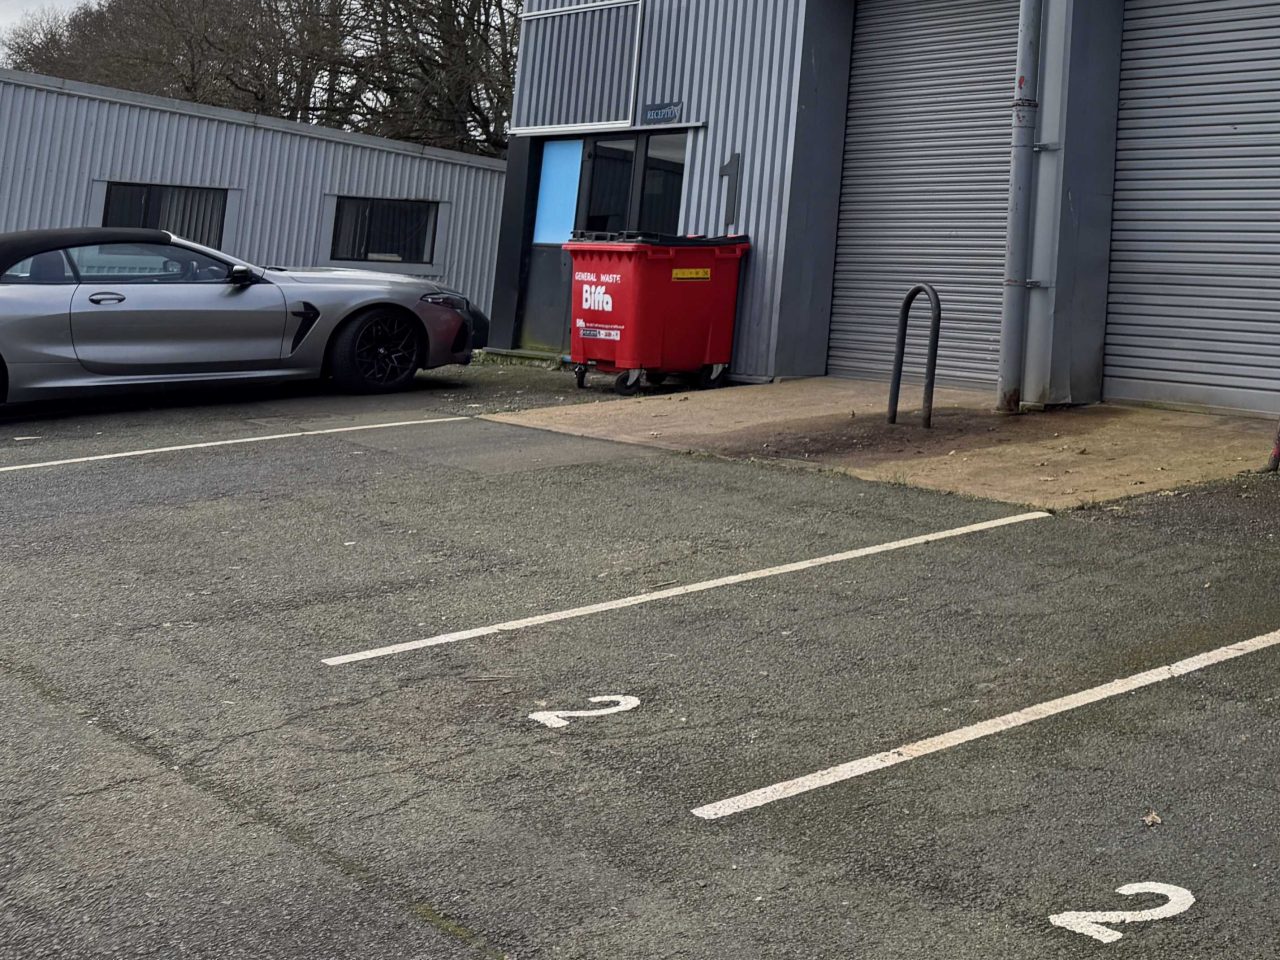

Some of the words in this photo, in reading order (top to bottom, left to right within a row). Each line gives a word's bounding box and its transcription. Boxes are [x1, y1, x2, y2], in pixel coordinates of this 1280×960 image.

[647, 107, 679, 120] RECEPTION
[719, 152, 740, 226] 1
[575, 271, 597, 282] GENERAL
[600, 273, 621, 284] WASTE
[582, 283, 613, 312] Biffa
[528, 694, 641, 728] 2
[1047, 881, 1196, 943] 2
